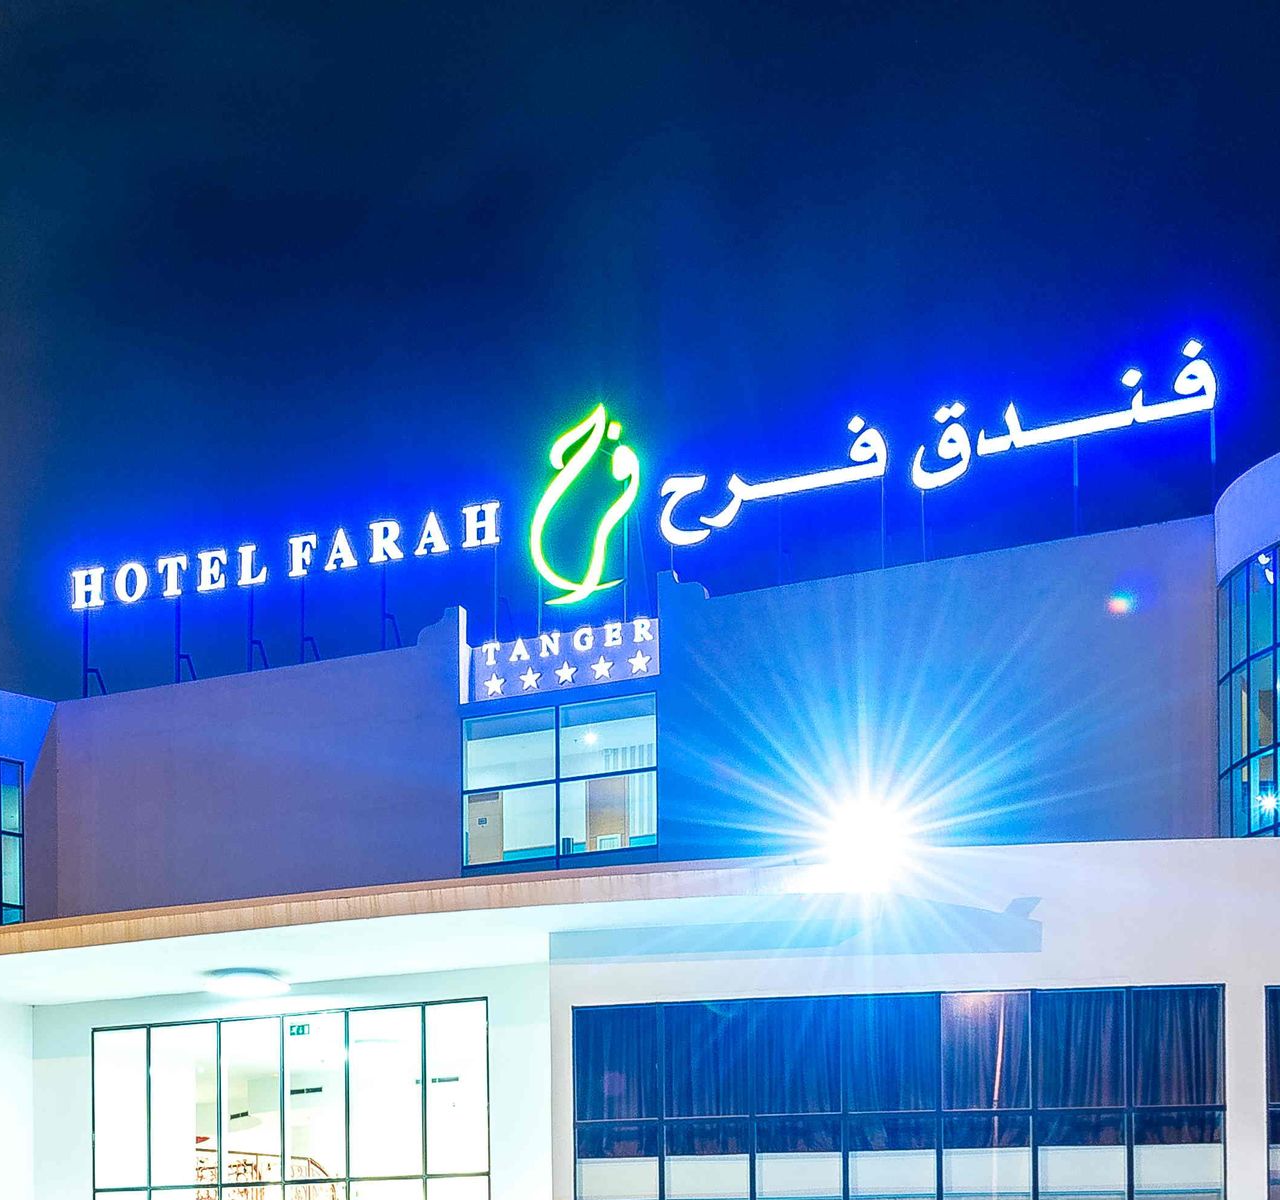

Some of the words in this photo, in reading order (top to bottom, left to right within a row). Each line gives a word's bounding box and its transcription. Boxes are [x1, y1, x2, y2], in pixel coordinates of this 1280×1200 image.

[911, 338, 1216, 489] فندق
[660, 415, 887, 545] فرح
[71, 544, 268, 609] HOTEL
[288, 501, 501, 577] FARAH
[482, 618, 653, 666] TANGER
